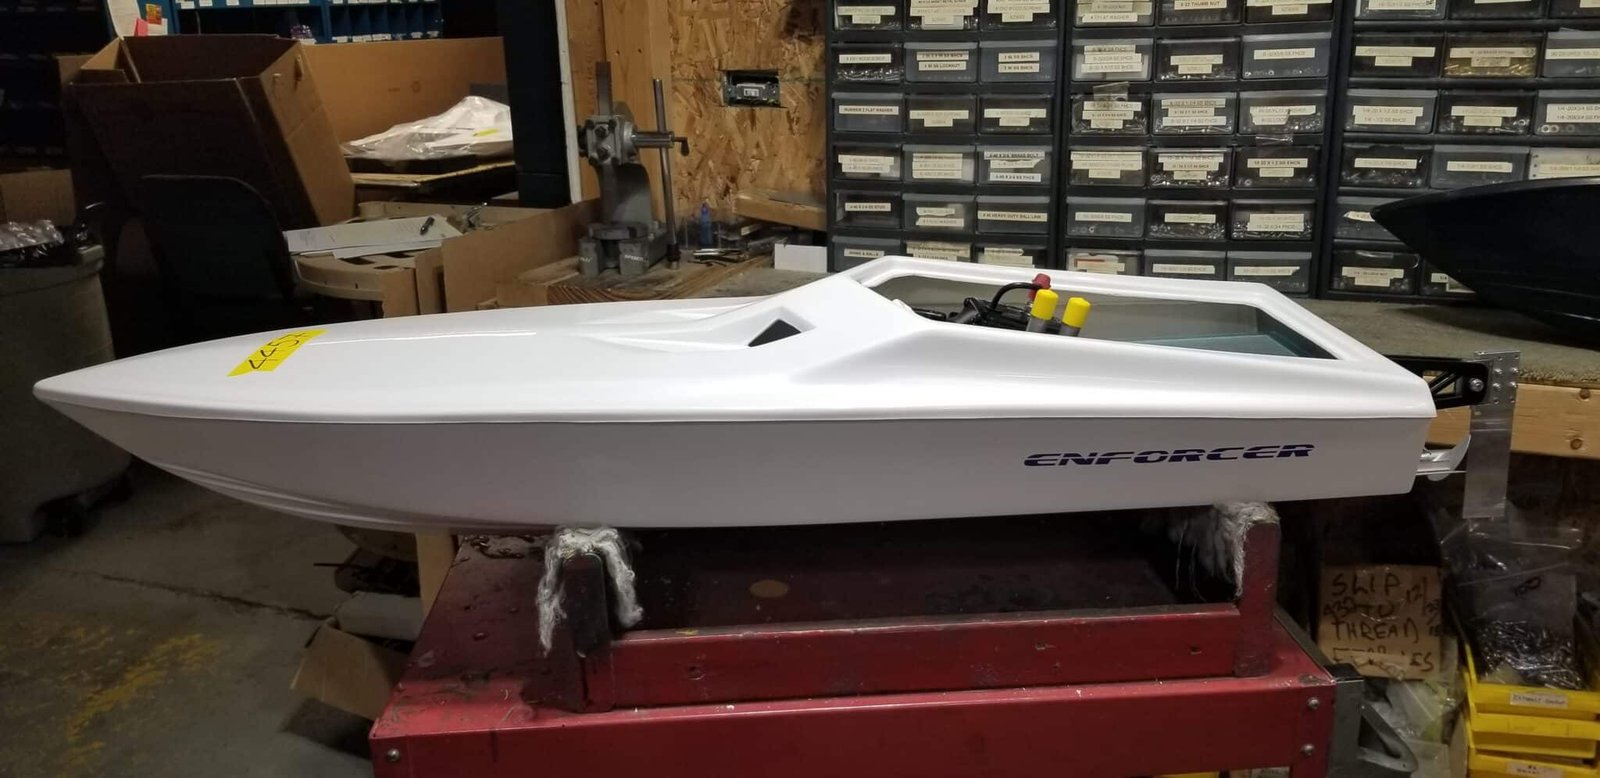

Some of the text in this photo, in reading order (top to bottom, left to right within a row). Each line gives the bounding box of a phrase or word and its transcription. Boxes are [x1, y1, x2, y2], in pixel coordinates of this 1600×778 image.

[1024, 444, 1315, 466] ENFORCER
[1331, 572, 1400, 597] SLIP
[1331, 616, 1420, 644] THREAD
